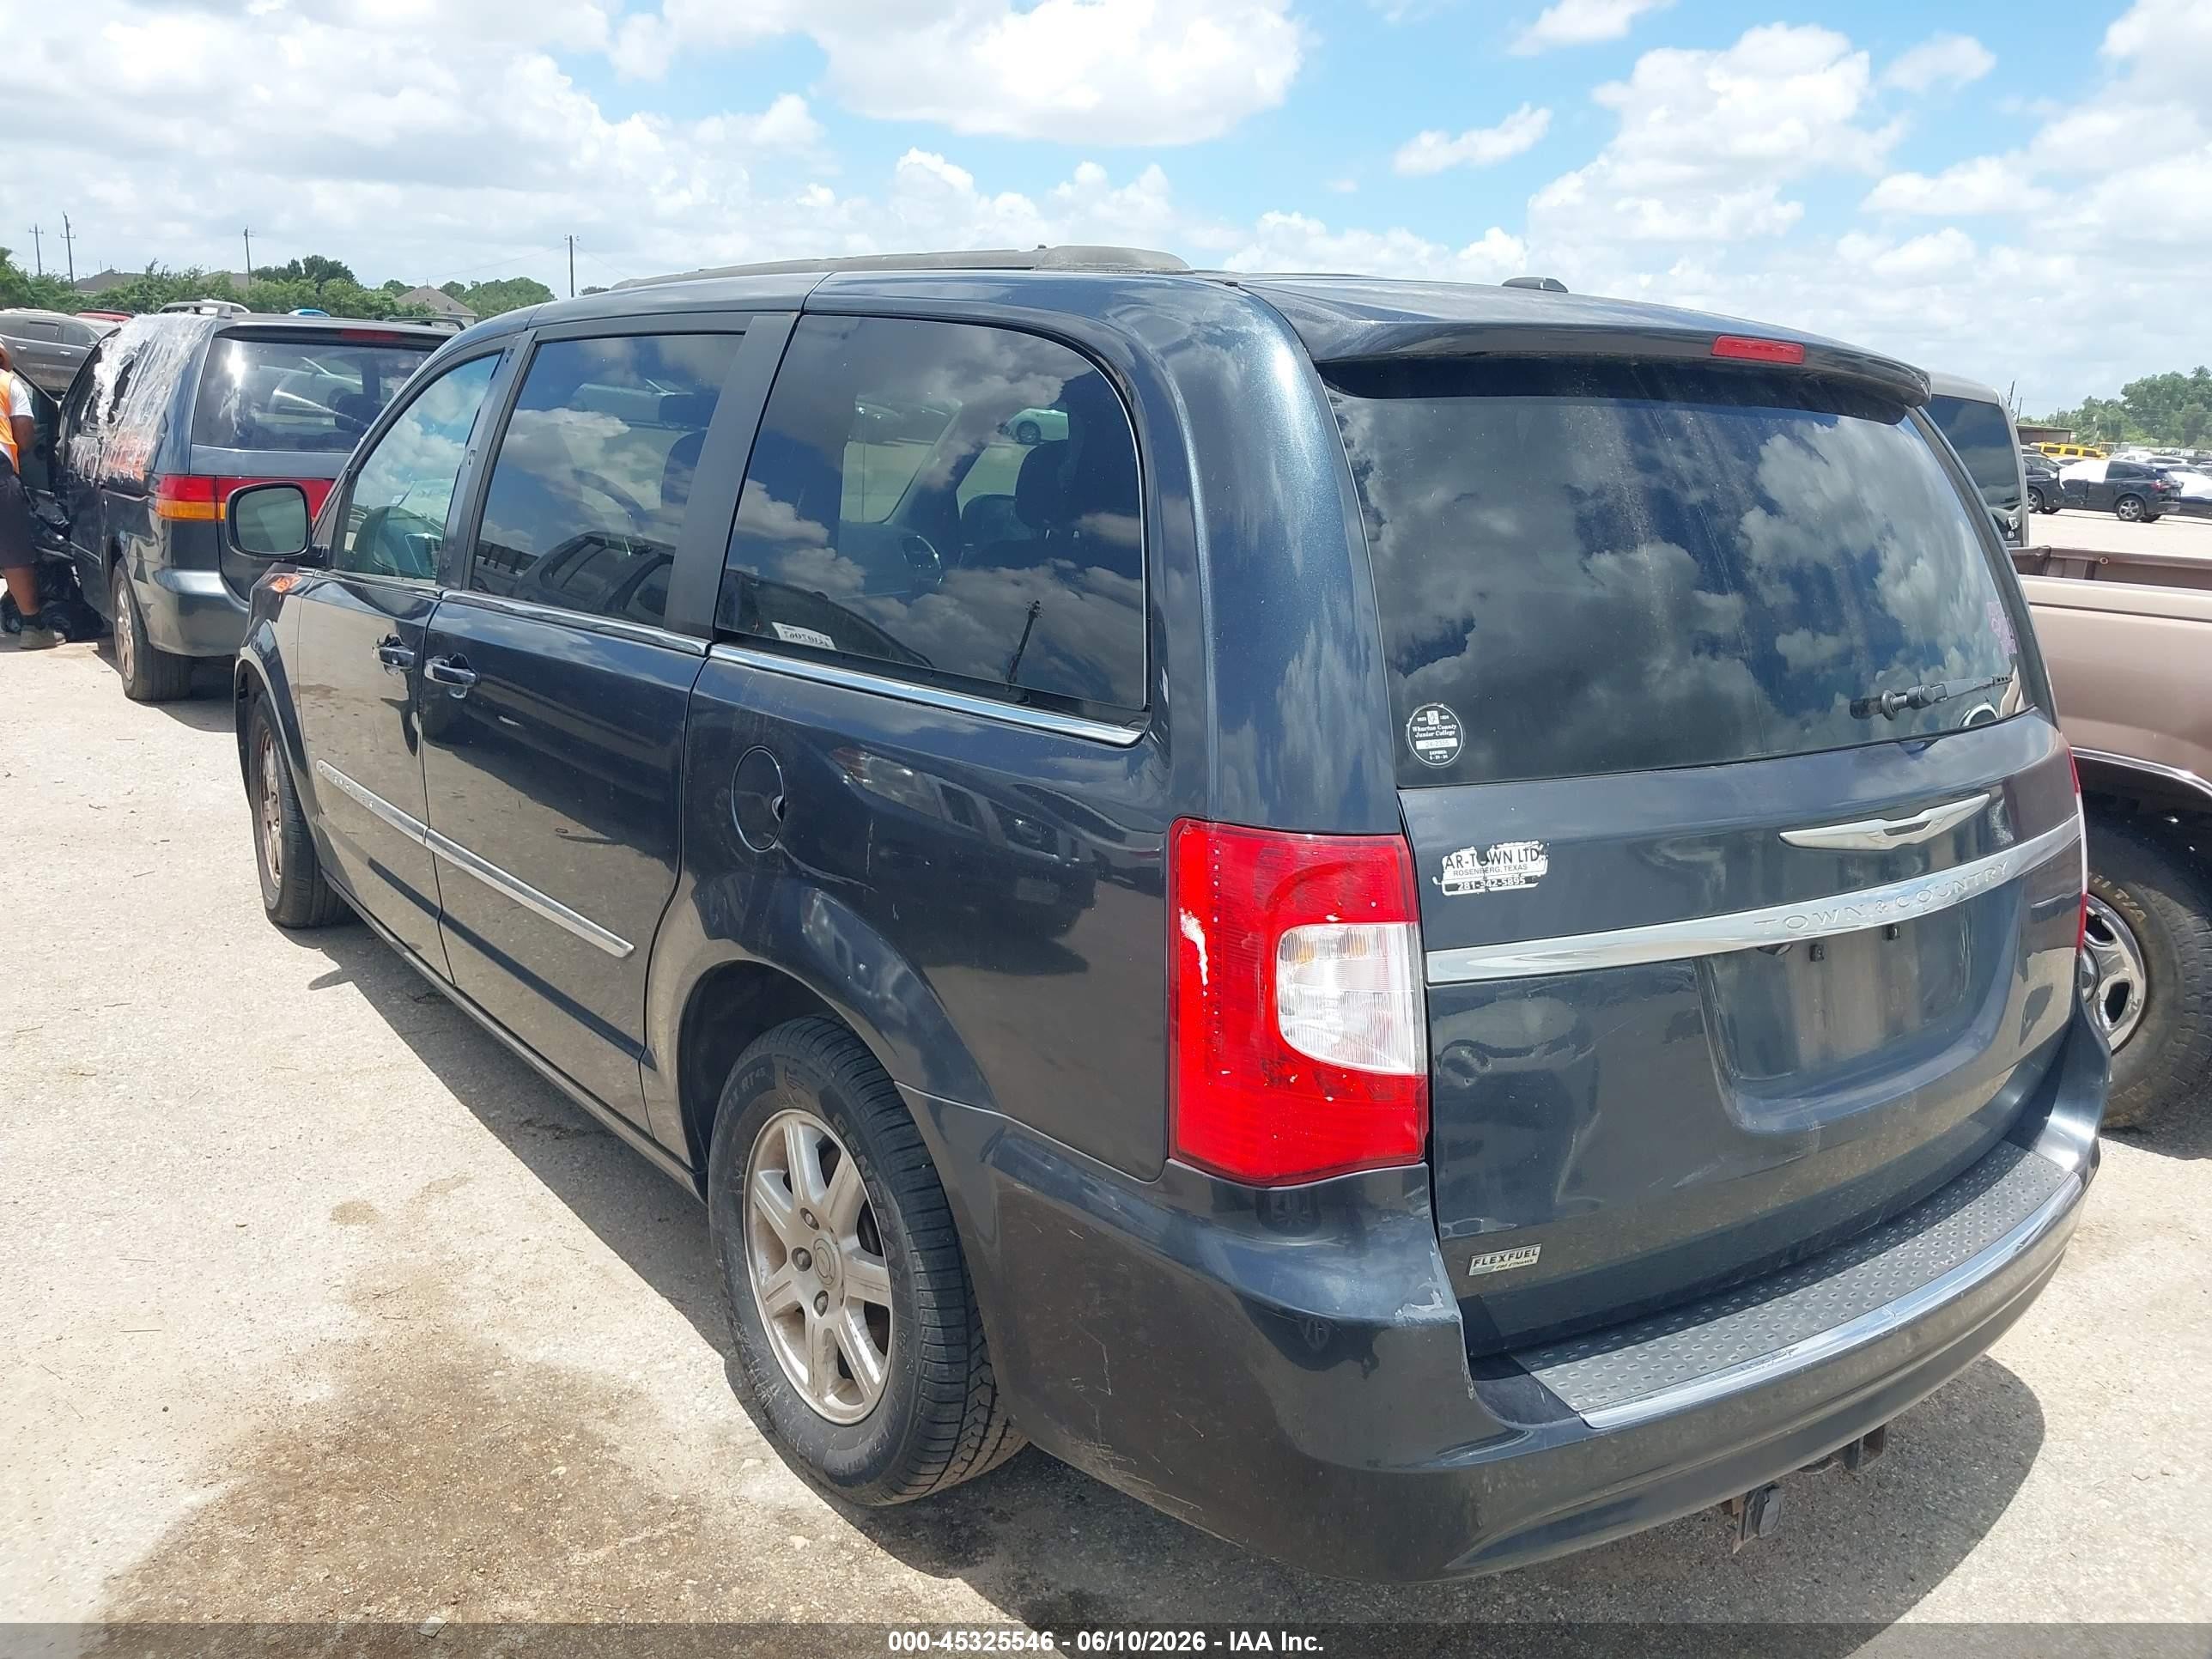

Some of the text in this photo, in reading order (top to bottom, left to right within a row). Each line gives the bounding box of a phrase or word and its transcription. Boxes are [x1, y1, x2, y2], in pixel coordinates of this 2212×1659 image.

[1753, 860, 2009, 935] TOWN & COUNTRY
[1474, 1249, 1538, 1267] FLEXFUEL
